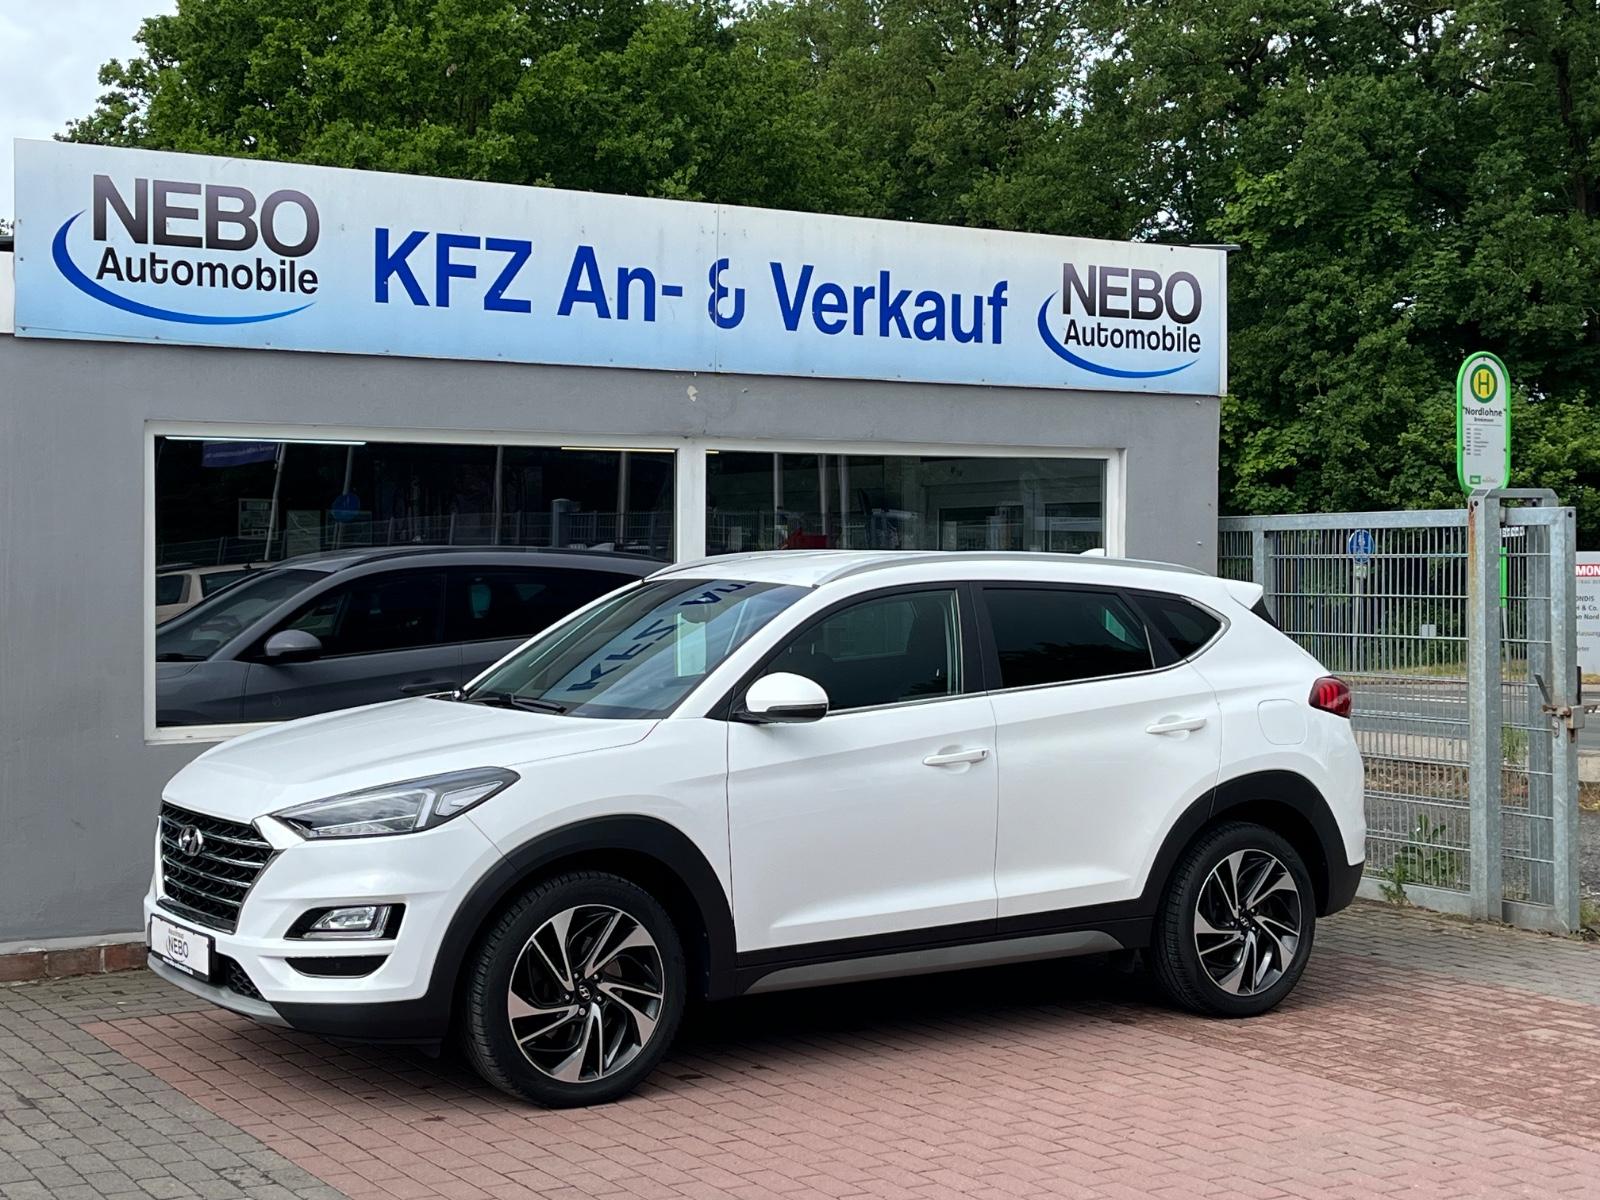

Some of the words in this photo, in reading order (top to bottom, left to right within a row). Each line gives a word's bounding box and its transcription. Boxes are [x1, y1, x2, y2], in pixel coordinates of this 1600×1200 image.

[93, 174, 320, 257] NEBO
[95, 246, 319, 294] Automobile
[374, 227, 532, 314] KFZ
[557, 245, 683, 322] An-
[708, 258, 745, 330] &
[770, 262, 1009, 345] Verkauf
[1062, 262, 1202, 325] NEBO
[1062, 318, 1202, 353] Automobile
[1478, 372, 1490, 395] H
[1464, 407, 1503, 417] Nordlohne
[168, 935, 189, 959] NEBO
